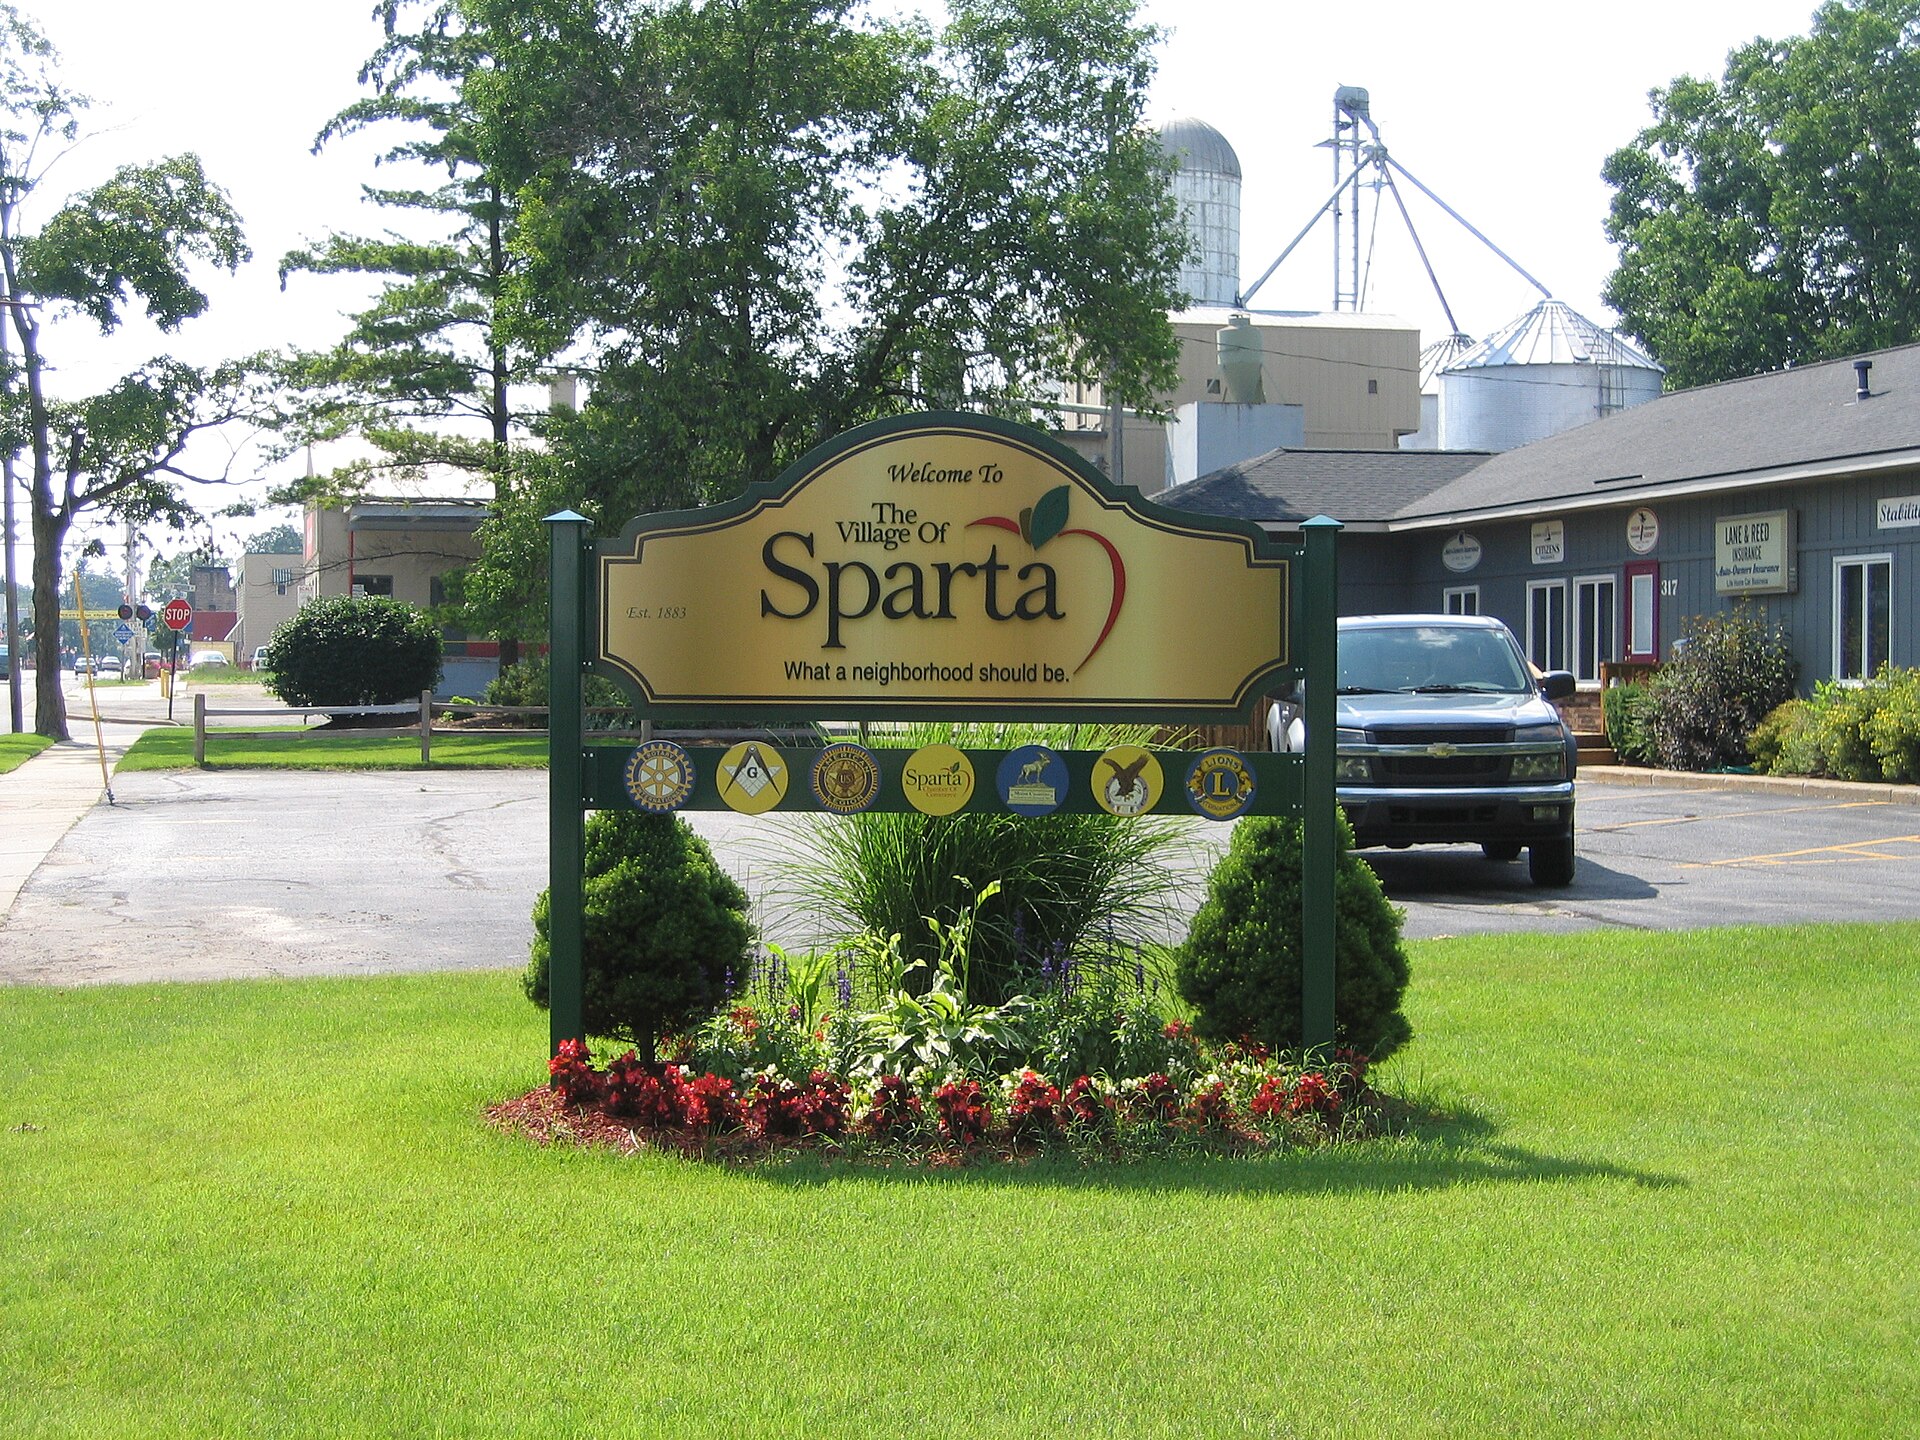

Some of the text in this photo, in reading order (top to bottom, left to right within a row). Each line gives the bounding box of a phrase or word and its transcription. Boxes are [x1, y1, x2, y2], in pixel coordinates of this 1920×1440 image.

[887, 461, 1003, 483] Welcome To
[871, 502, 918, 524] The
[1880, 502, 1920, 522] Stabilit
[835, 521, 950, 550] Village Of
[1725, 523, 1769, 545] LANE & REED
[760, 531, 1066, 649] Sparta
[1661, 579, 1678, 596] 317
[166, 608, 190, 620] STOP
[626, 606, 687, 619] Est. 1883
[784, 661, 1070, 686] What a neighborhood should be.
[645, 750, 675, 759] ROTARY
[821, 753, 870, 773] AMERICAN
[1205, 756, 1240, 769] LIONS
[747, 767, 758, 779] G
[905, 769, 962, 791] Sparta
[1212, 772, 1230, 795] L
[827, 794, 864, 805] LEGION
